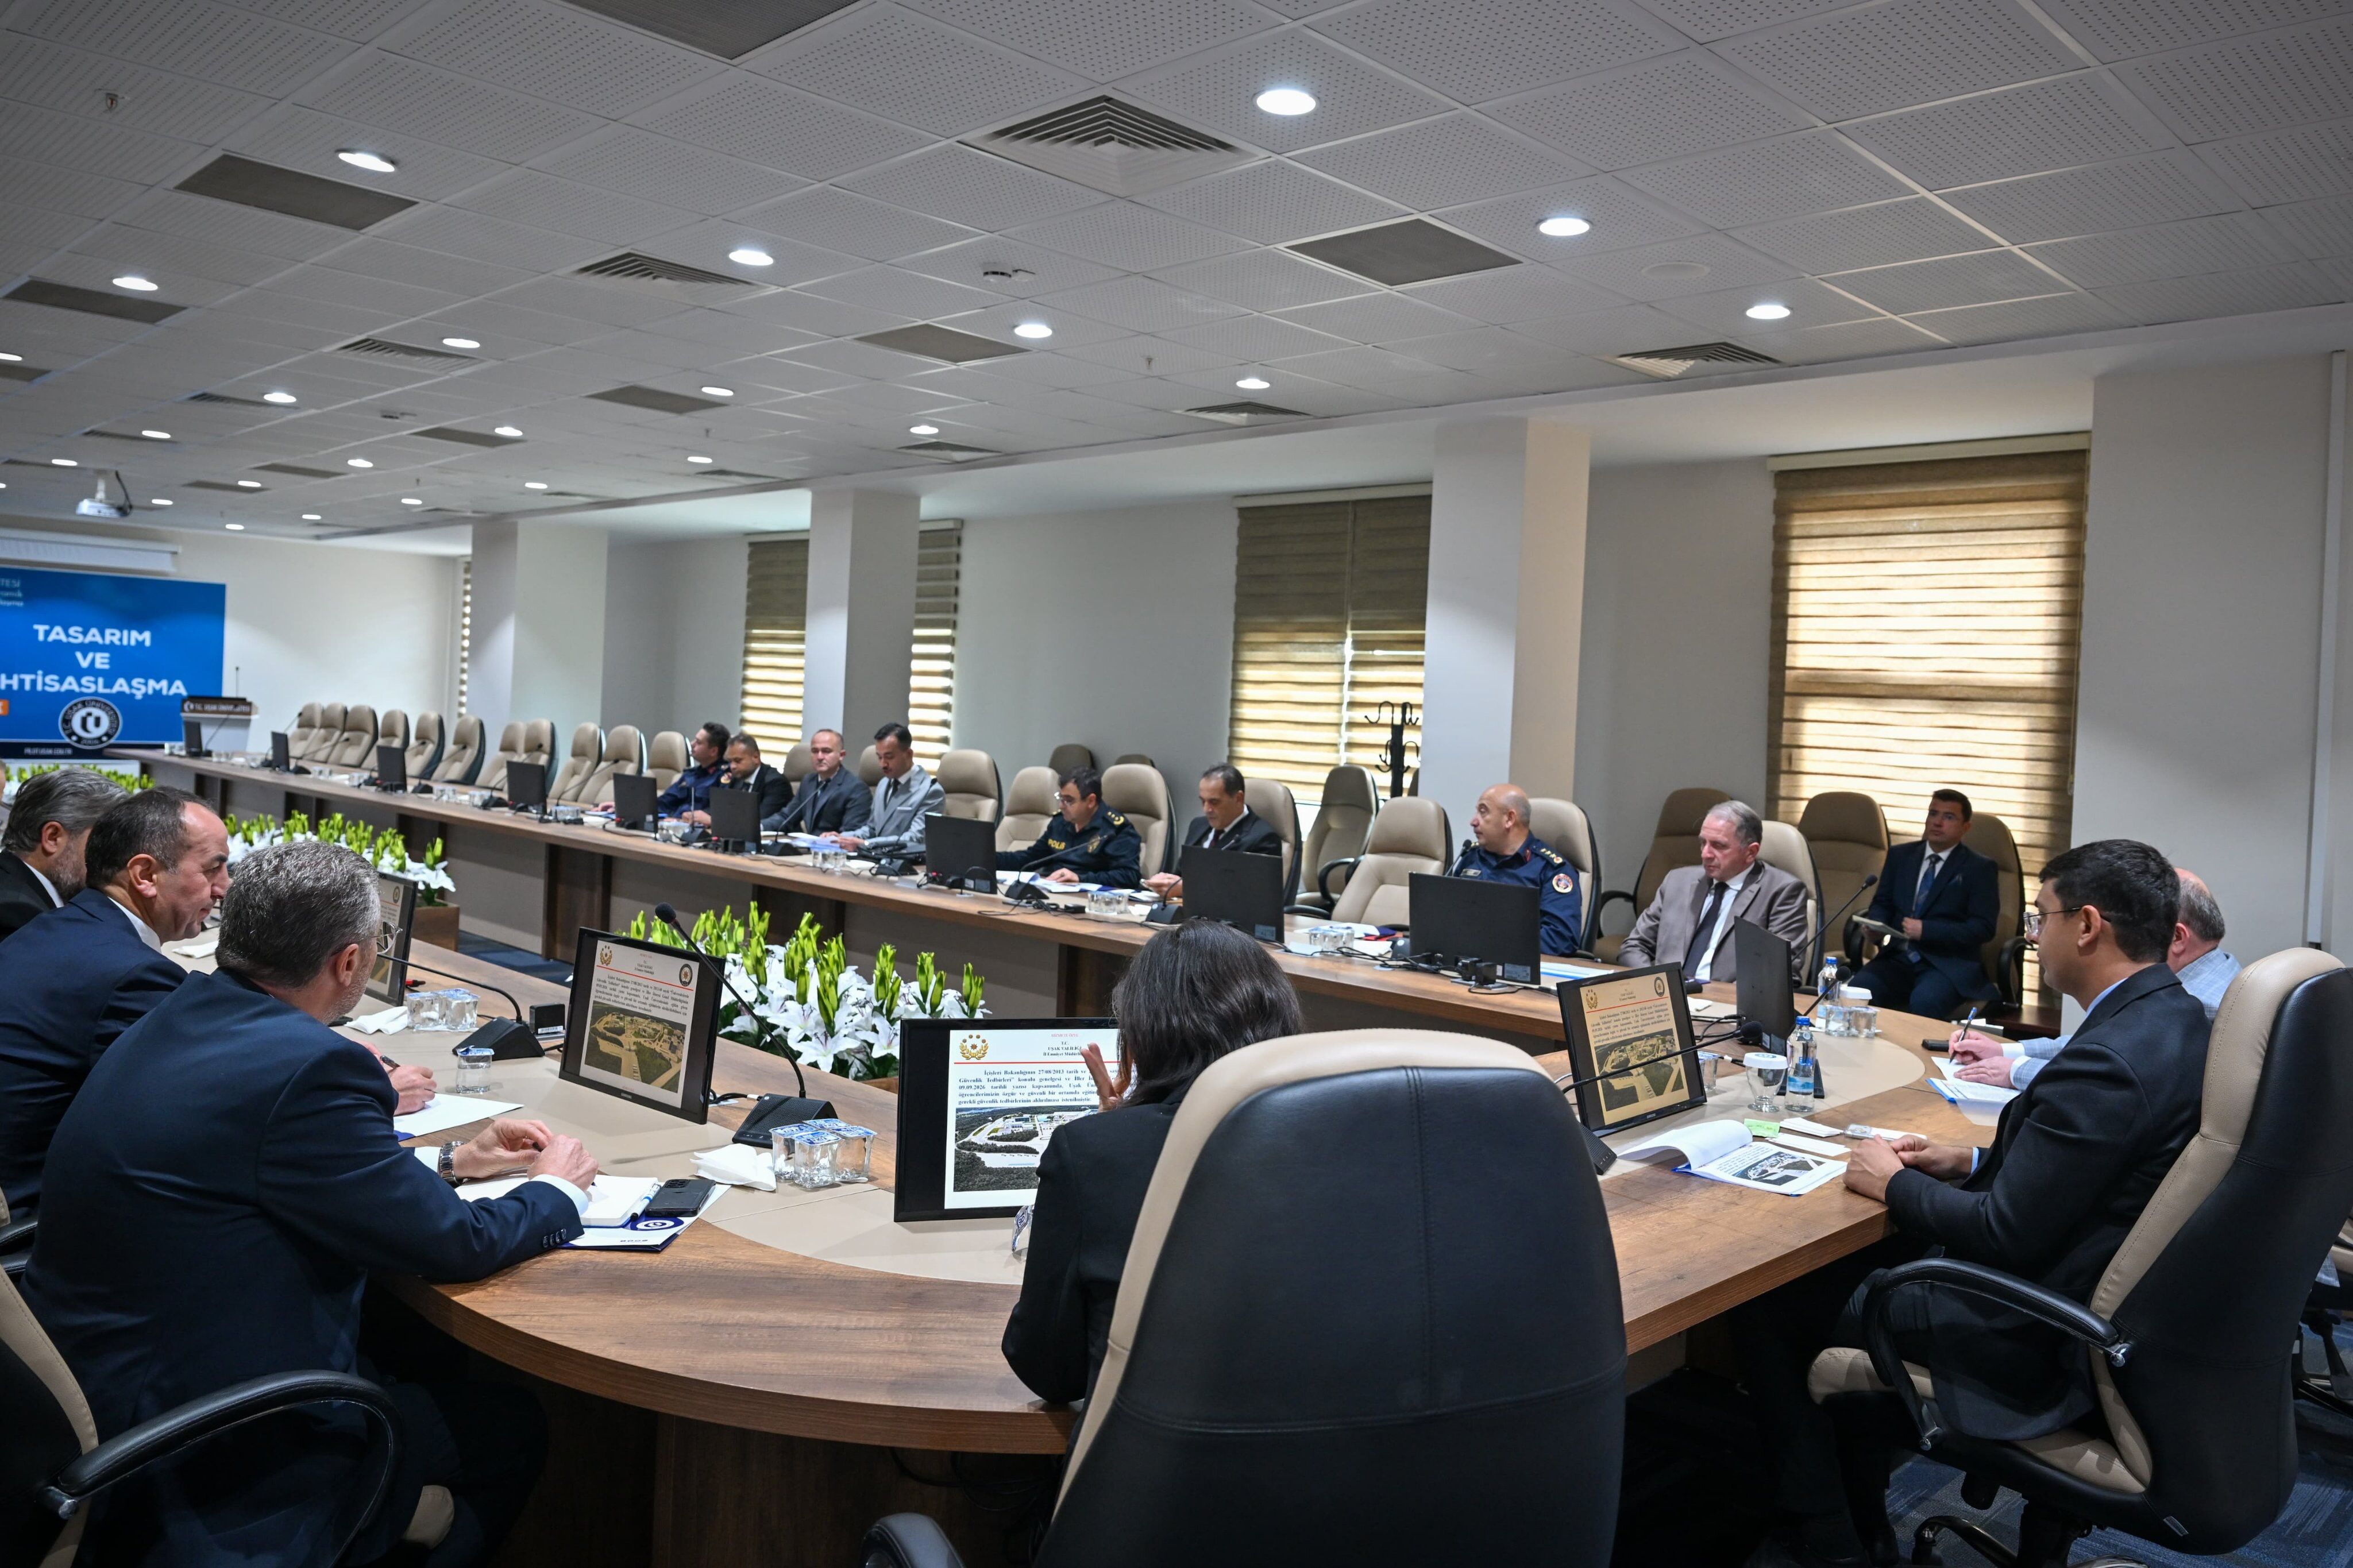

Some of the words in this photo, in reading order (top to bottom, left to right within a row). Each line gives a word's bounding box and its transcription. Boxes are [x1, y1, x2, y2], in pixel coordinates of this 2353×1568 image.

[33, 624, 152, 647] TASARIM
[75, 651, 110, 669] VE
[0, 670, 188, 700] HTİSASLAŞMA
